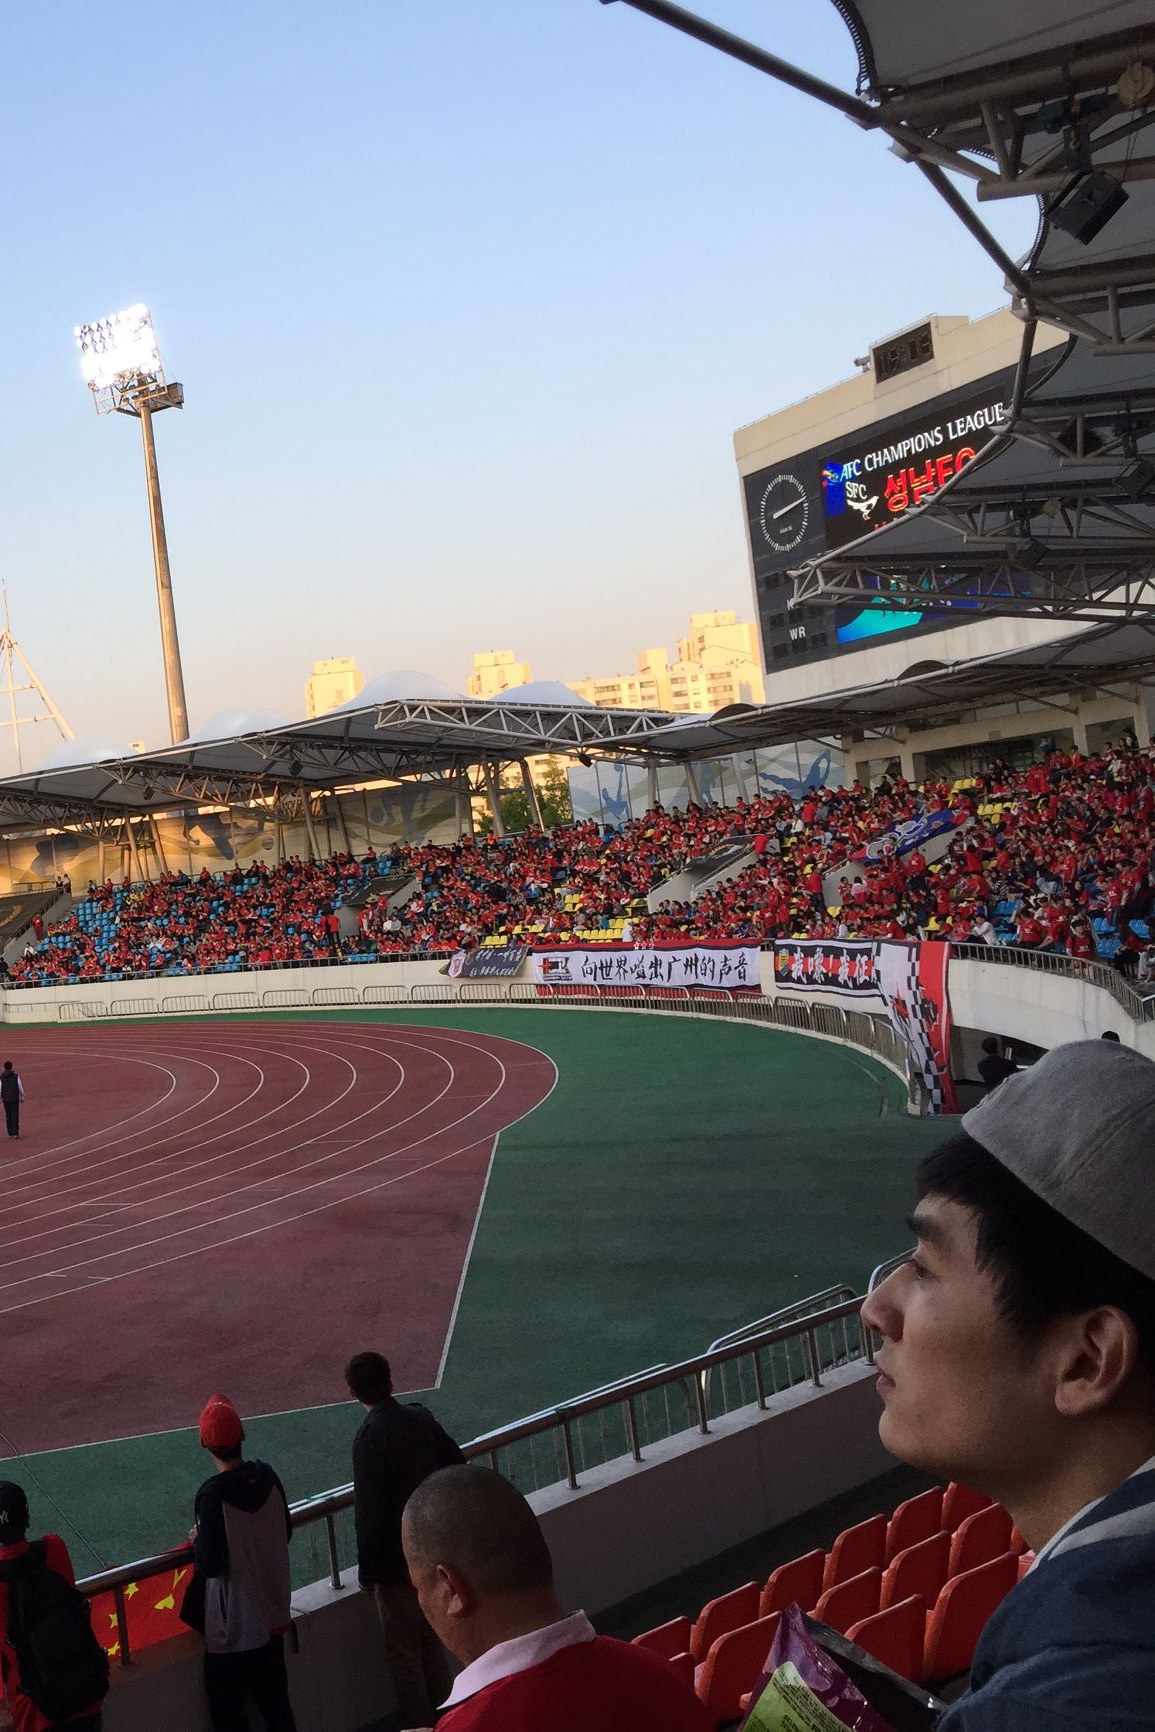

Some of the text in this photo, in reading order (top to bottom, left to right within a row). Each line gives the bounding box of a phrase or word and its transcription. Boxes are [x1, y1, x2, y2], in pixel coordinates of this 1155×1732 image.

[841, 402, 1005, 482] AFC CHAMPIONS LEAGUE
[845, 481, 868, 499] SFC
[789, 626, 807, 641] WR
